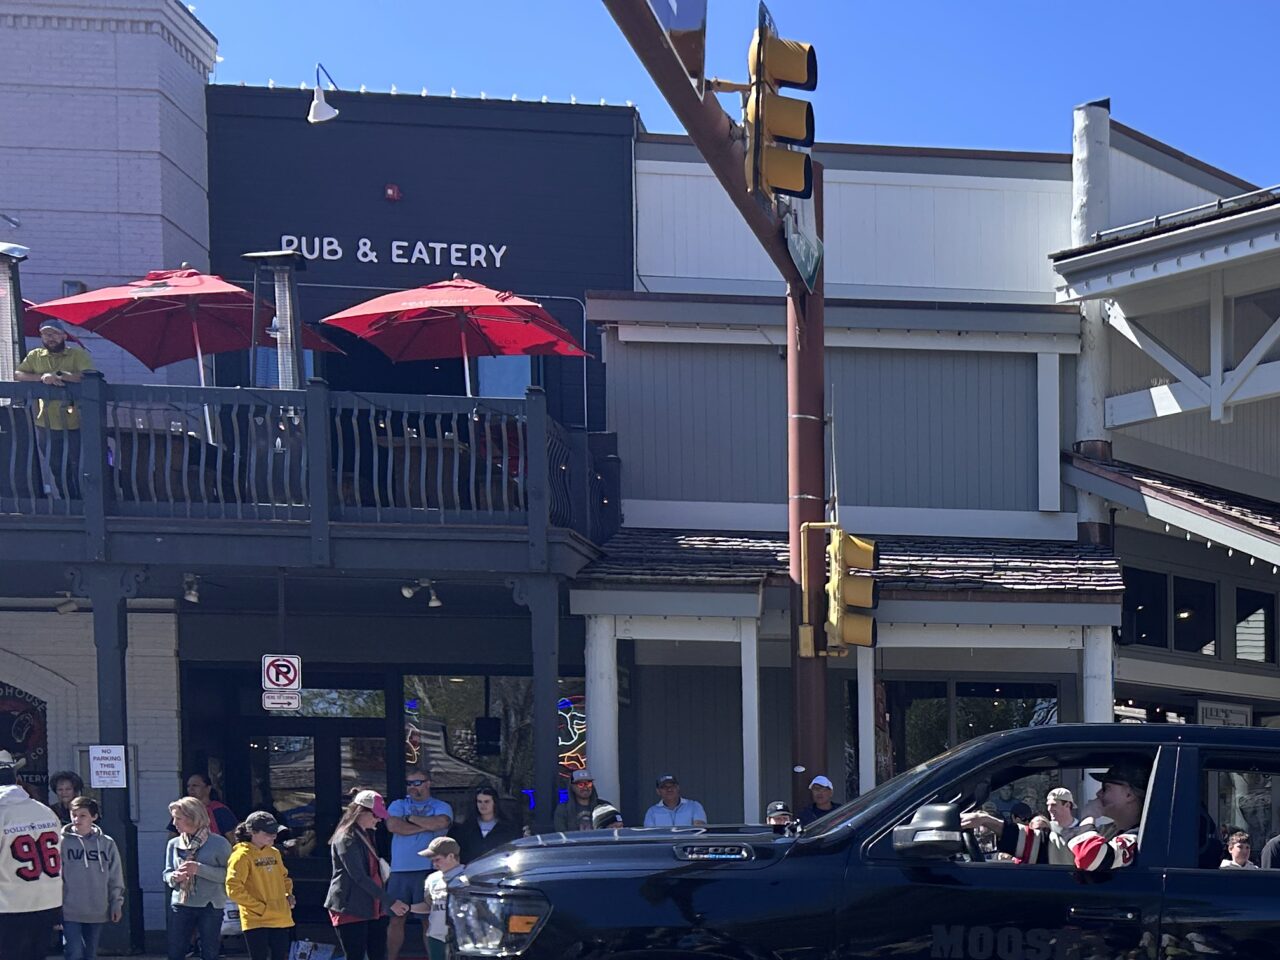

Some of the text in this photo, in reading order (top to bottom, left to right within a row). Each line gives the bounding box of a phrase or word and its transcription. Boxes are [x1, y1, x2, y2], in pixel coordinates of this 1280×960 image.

[281, 235, 507, 268] PUB & EATERY
[10, 831, 61, 881] 96
